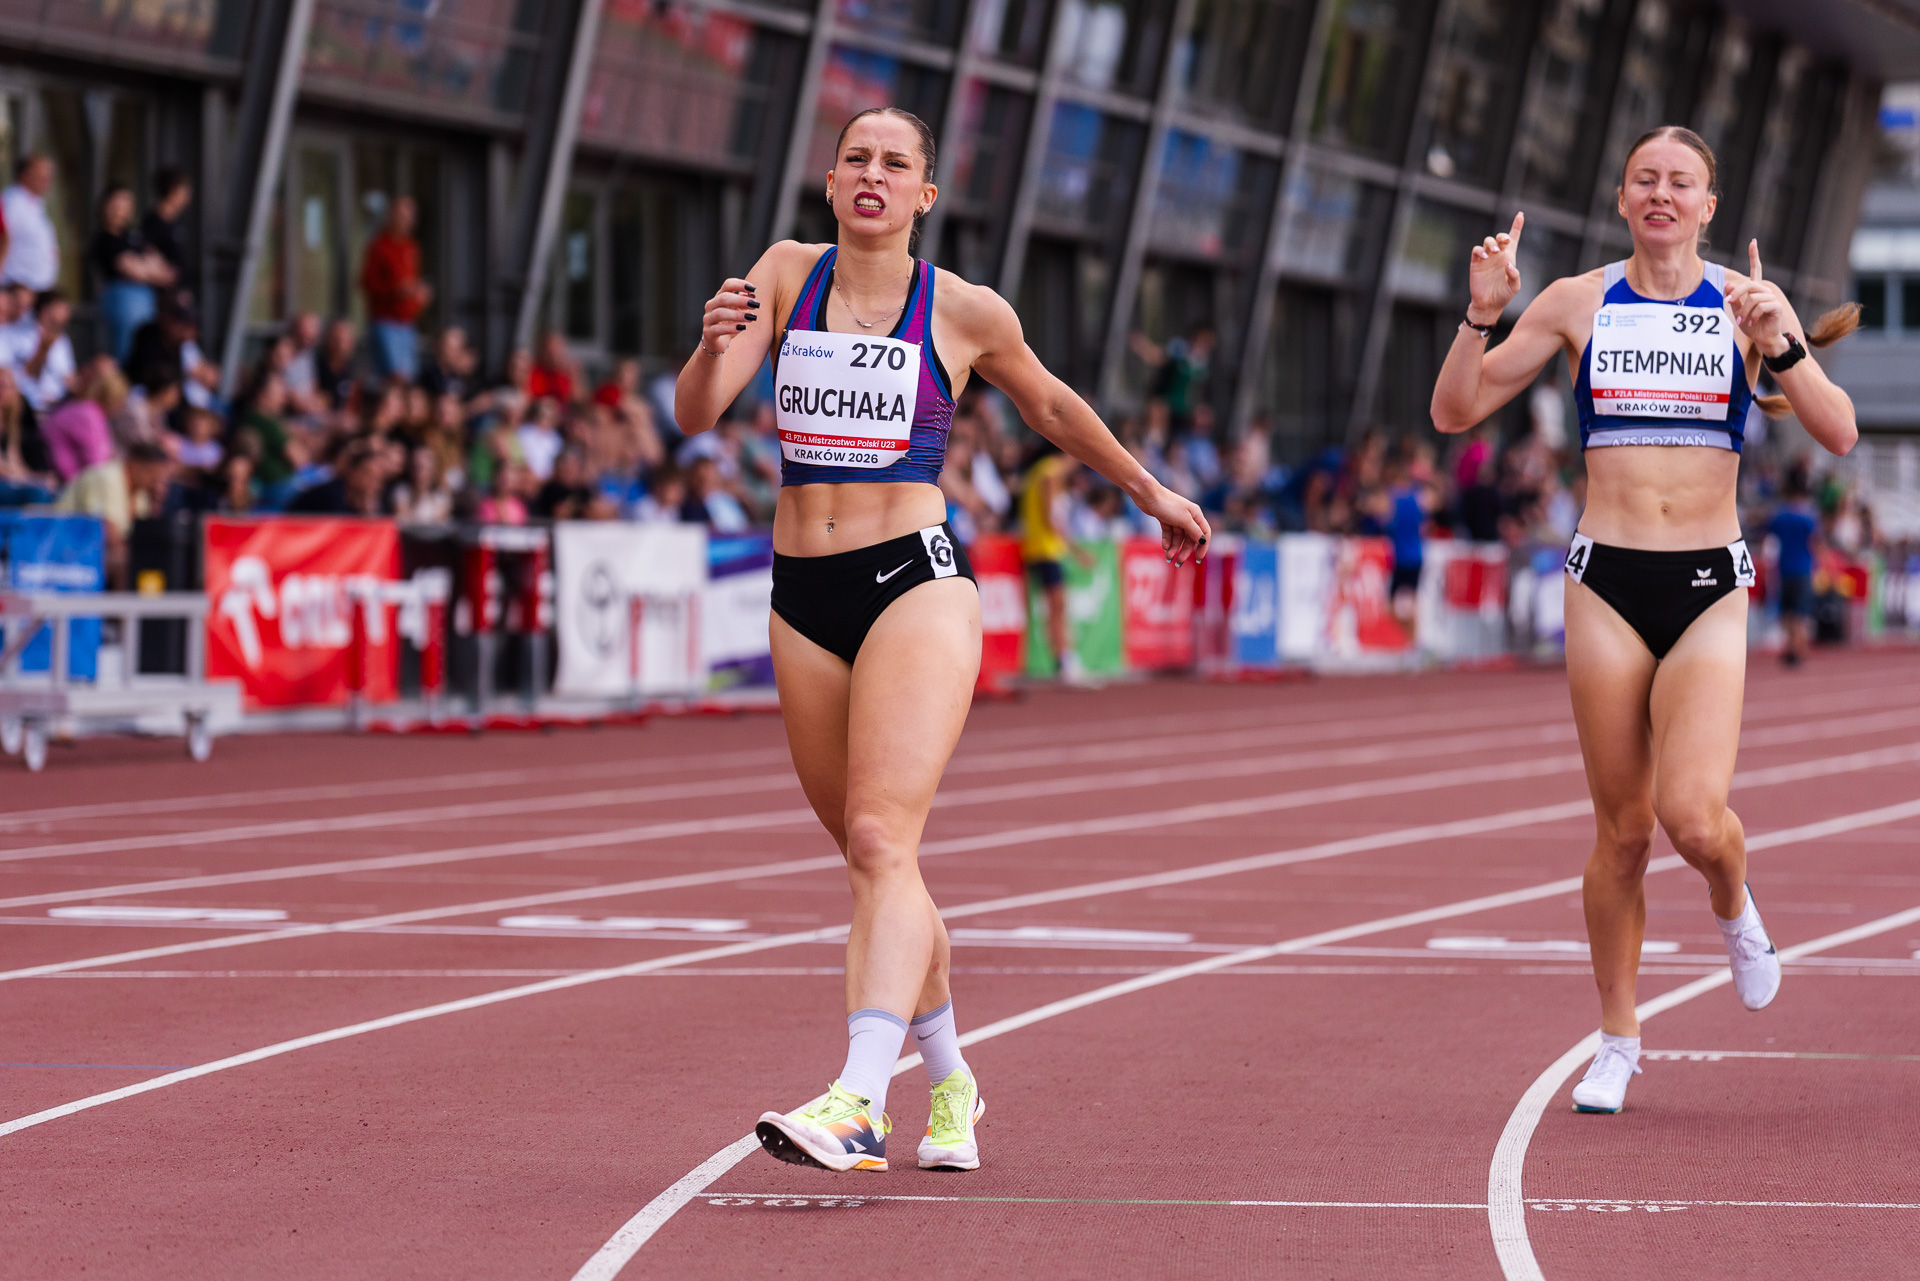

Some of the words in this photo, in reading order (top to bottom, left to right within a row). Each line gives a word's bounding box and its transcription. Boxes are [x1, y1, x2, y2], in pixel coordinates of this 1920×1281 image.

[1672, 312, 1720, 335] 392
[792, 345, 834, 359] Kraków
[850, 342, 906, 371] 270
[1596, 350, 1725, 378] STEMPNIAK
[779, 384, 906, 422] GRUCHAŁA
[1602, 389, 1614, 398] 43.
[1615, 390, 1632, 399] PZLA
[1633, 390, 1679, 400] Mistrzostwa
[1680, 392, 1703, 401] Polski
[1703, 394, 1718, 402] U23
[1616, 401, 1670, 414] KRAKÓW
[1673, 405, 1702, 415] 2026
[785, 432, 793, 442] 43.
[793, 434, 807, 444] PZLA
[808, 435, 855, 447] Mistrzostwa
[857, 439, 879, 448] Polski
[880, 441, 896, 449] U23
[1641, 432, 1707, 447] POZNAŃ
[794, 448, 845, 462] KRAKÓW
[848, 453, 879, 464] 2026
[930, 534, 952, 567] 6
[1568, 544, 1587, 574] 4
[1739, 549, 1754, 579] 4
[1691, 578, 1718, 588] erima
[1531, 1203, 1688, 1213] 400
